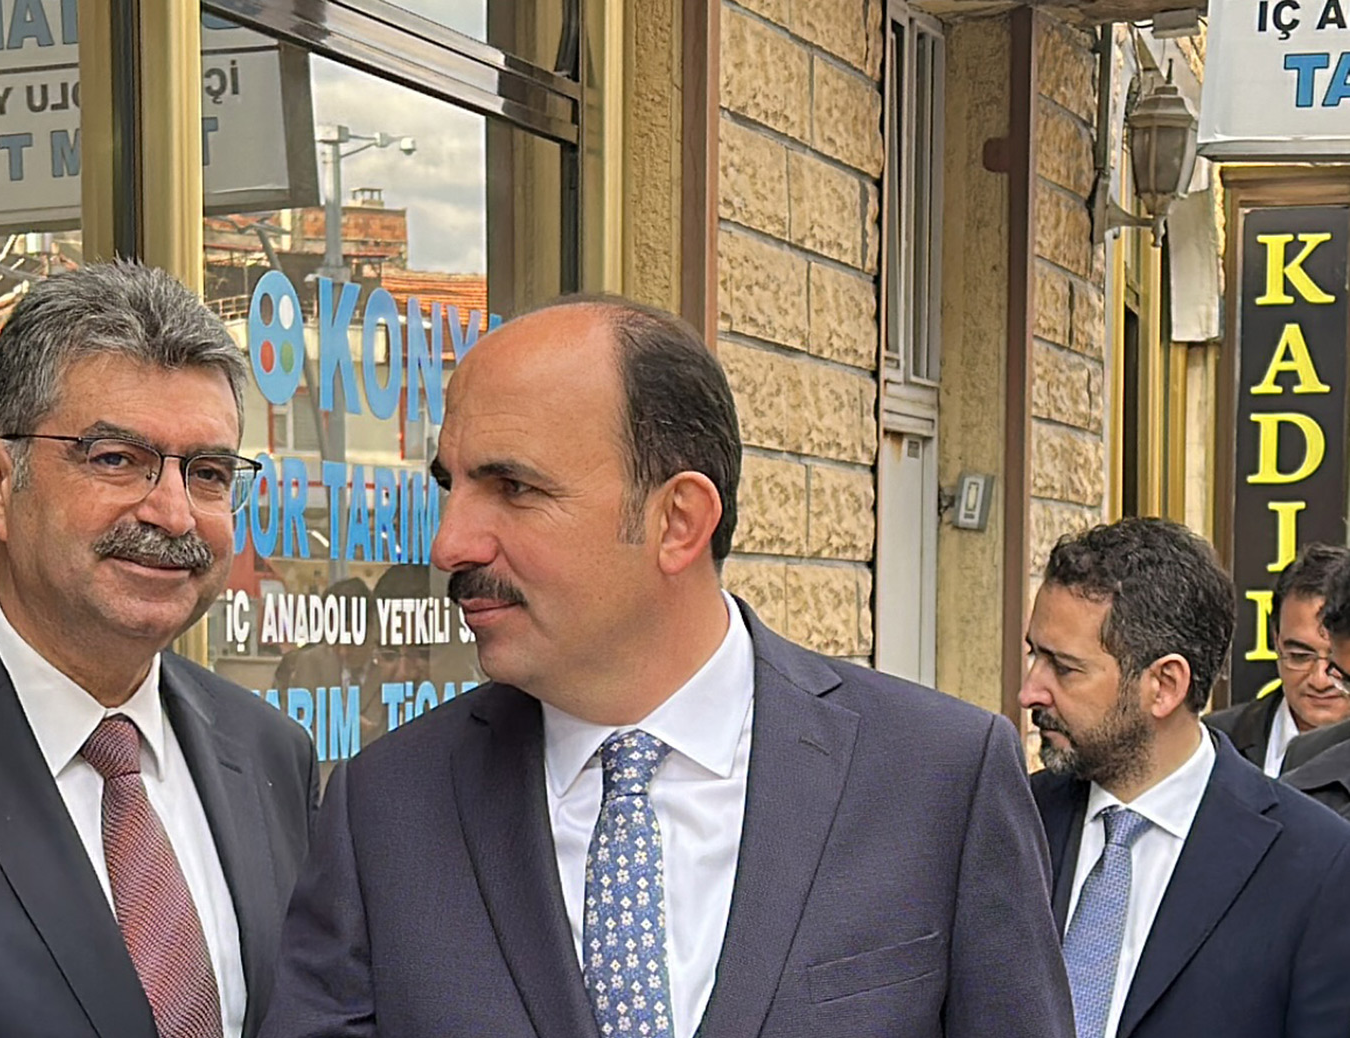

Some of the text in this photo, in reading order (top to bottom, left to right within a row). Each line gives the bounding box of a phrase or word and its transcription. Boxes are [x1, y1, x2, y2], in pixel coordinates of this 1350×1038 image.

[319, 276, 502, 425] KONY
[261, 593, 367, 646] ANADOLU
[376, 597, 450, 646] YETKİLİ
